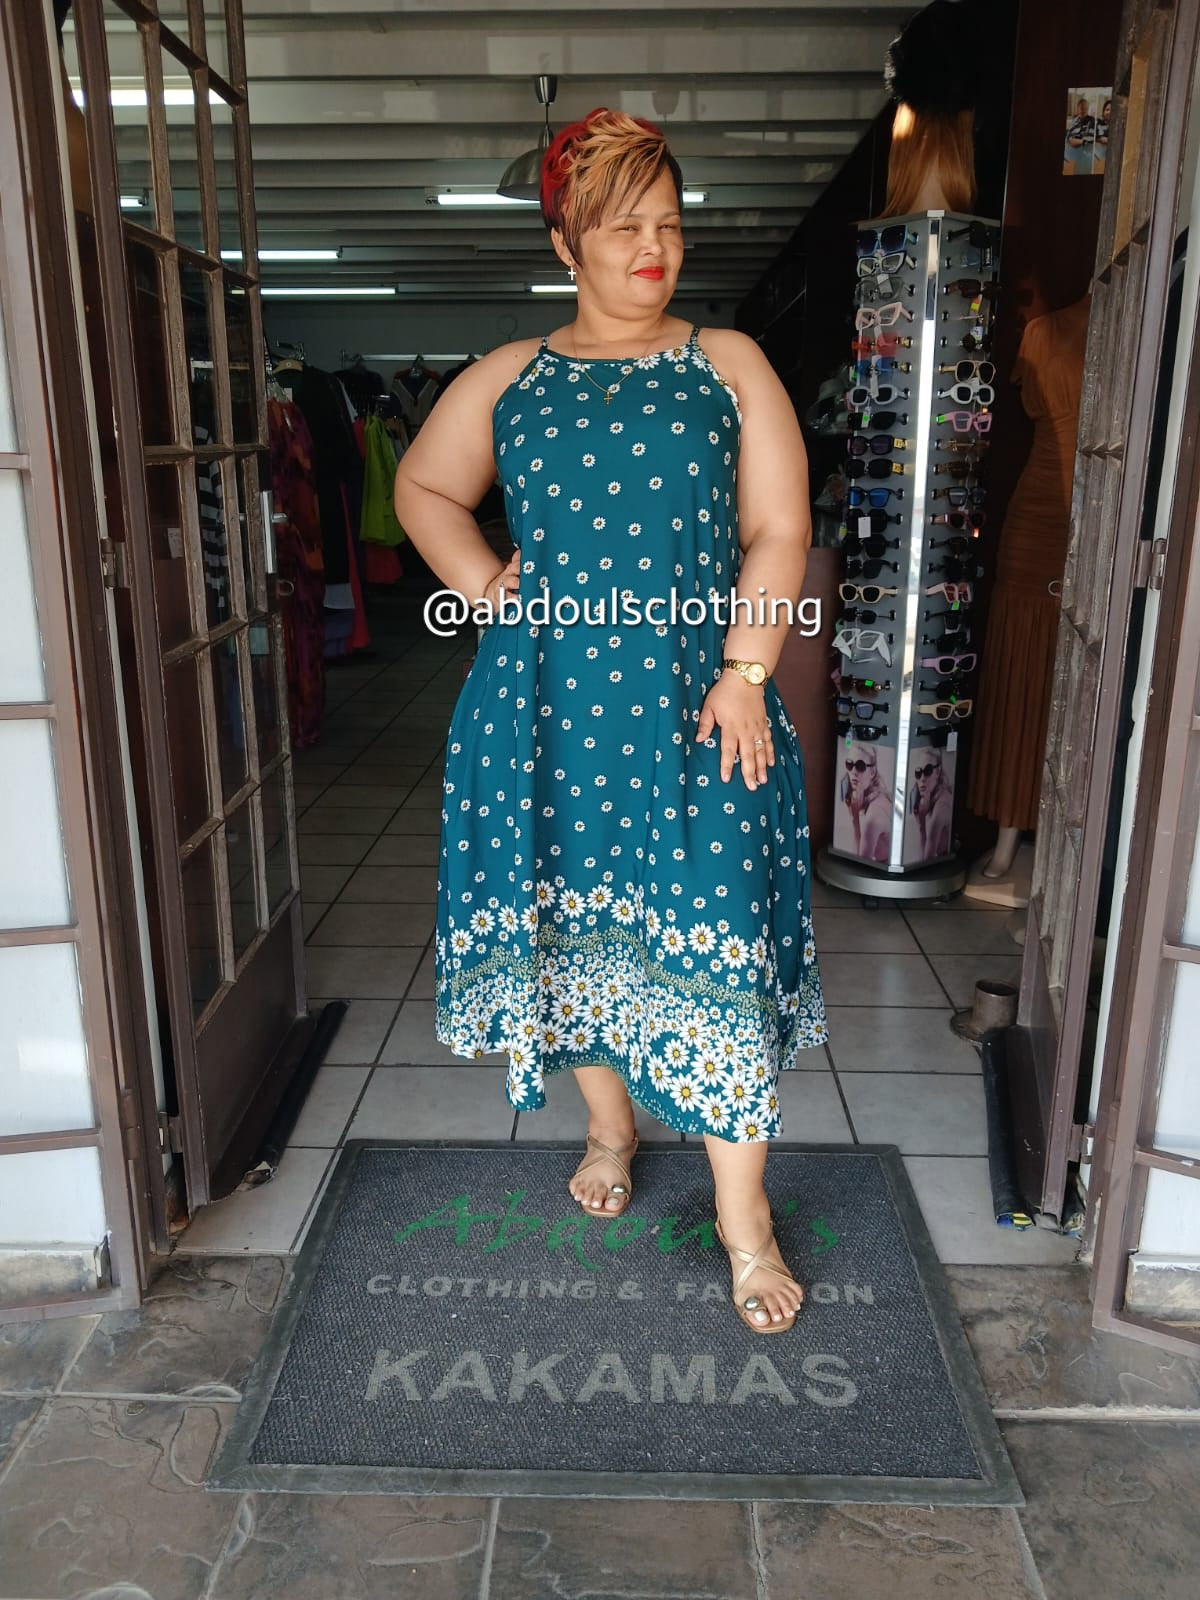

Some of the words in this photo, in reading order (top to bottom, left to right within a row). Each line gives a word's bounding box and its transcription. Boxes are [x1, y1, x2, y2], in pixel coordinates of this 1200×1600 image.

[366, 1273, 597, 1299] CLOTHING
[617, 1280, 643, 1300] &
[676, 1282, 875, 1305] FAON
[364, 1349, 860, 1408] KAKAMAS
